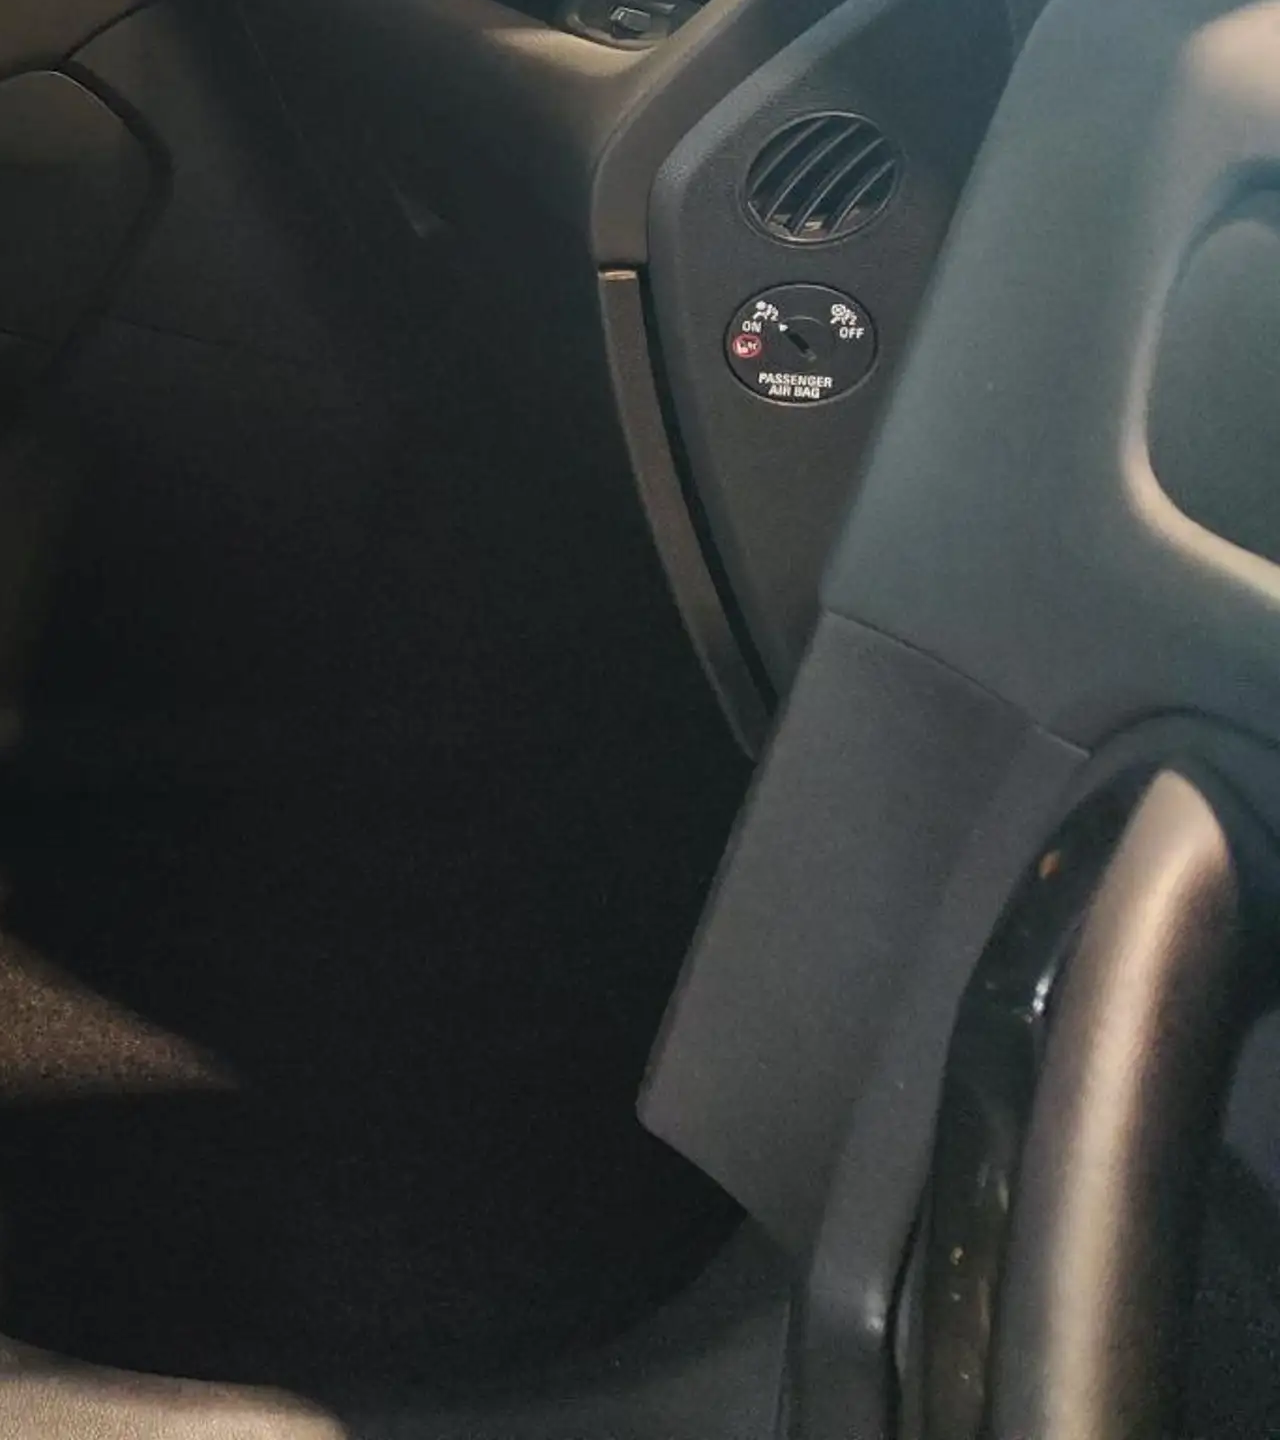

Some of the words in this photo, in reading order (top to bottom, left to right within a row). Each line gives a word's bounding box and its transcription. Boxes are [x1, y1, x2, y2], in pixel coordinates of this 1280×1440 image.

[742, 320, 762, 333] ON
[839, 326, 865, 339] OFF
[758, 372, 833, 388] PASSENGER
[768, 384, 791, 396] AIR
[793, 386, 820, 398] BAG
